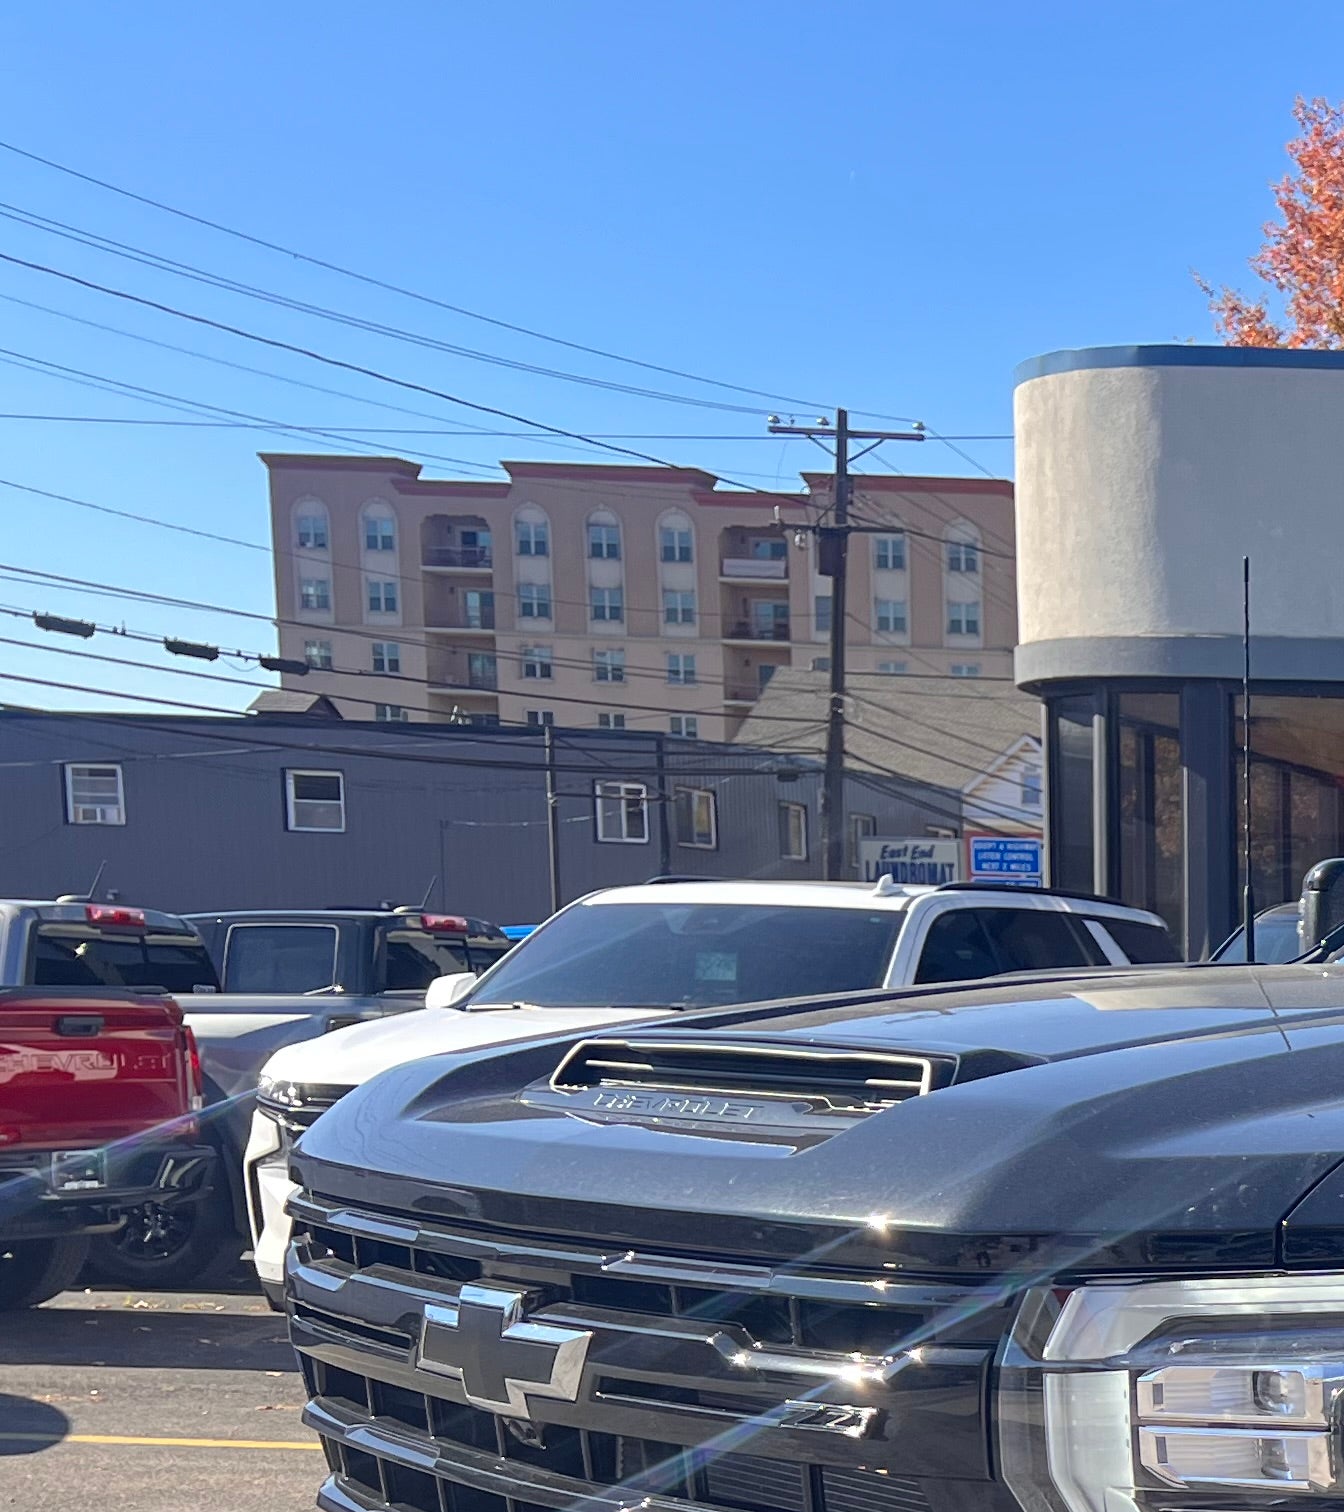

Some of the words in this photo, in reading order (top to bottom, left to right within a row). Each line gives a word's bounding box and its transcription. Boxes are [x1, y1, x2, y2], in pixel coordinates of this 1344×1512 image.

[881, 845, 908, 859] East
[911, 845, 935, 860] End
[865, 860, 955, 884] LAUNDROMAT
[593, 1092, 765, 1119] CHEVROLET
